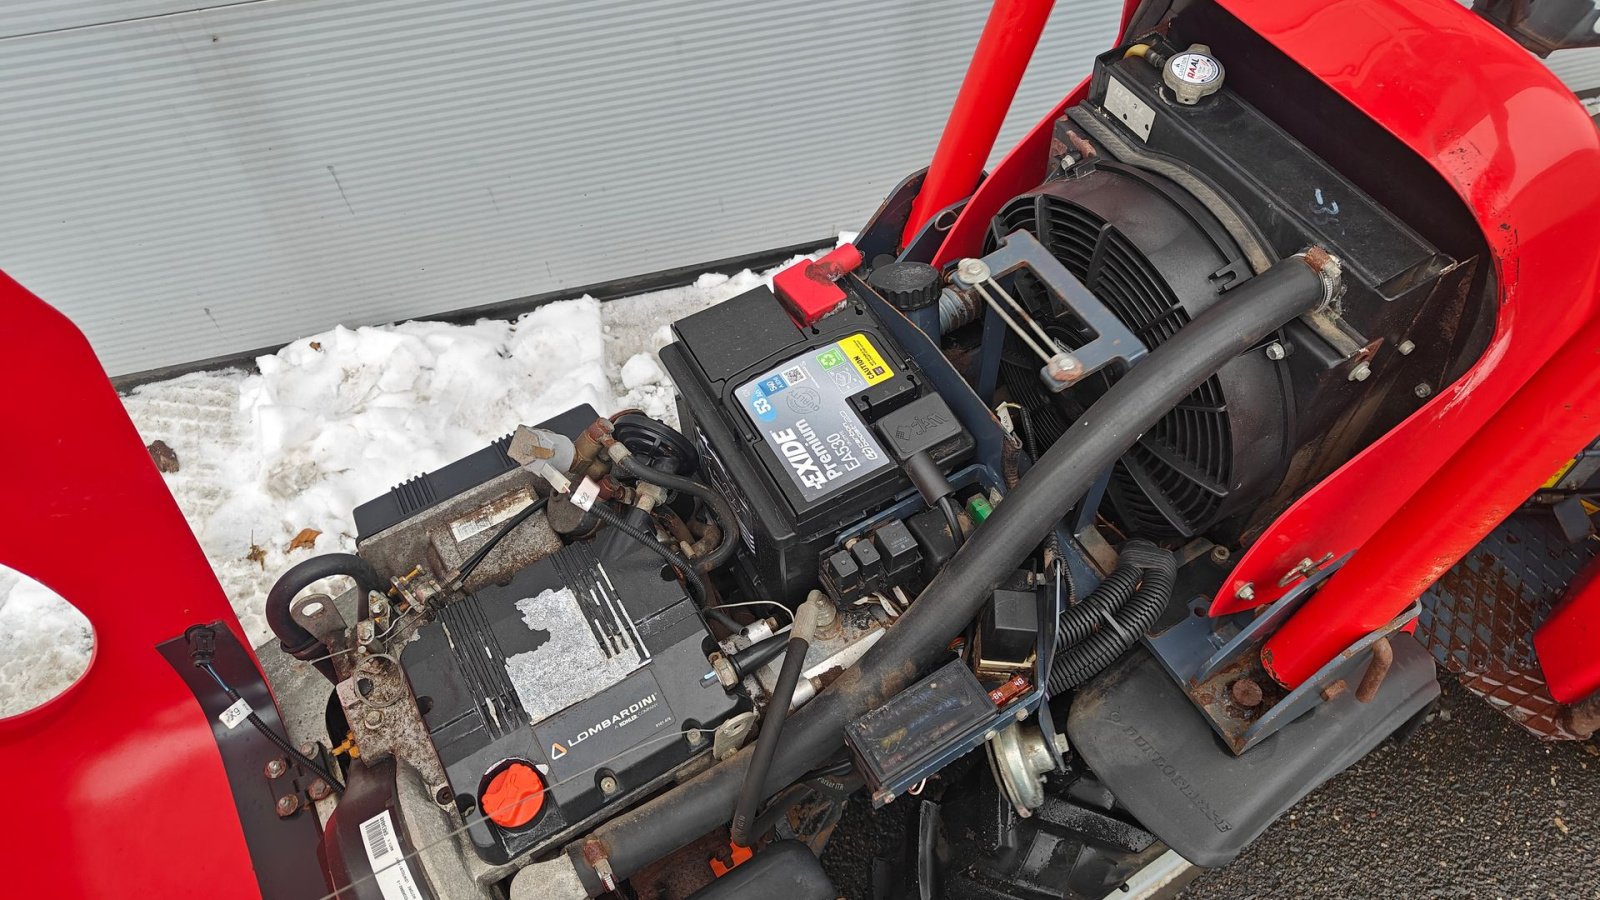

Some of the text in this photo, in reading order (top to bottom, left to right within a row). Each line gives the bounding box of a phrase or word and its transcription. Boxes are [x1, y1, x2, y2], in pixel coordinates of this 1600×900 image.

[1186, 58, 1200, 79] RAAL
[854, 355, 875, 380] CAUTION
[753, 397, 772, 415] 53
[787, 389, 820, 412] QUALITY
[771, 427, 827, 490] EXIDE
[795, 418, 844, 480] Premium
[826, 433, 861, 471] EA530
[576, 491, 590, 507] X22
[567, 693, 657, 748] LOMBARDINI
[618, 713, 639, 729] KOHLER
